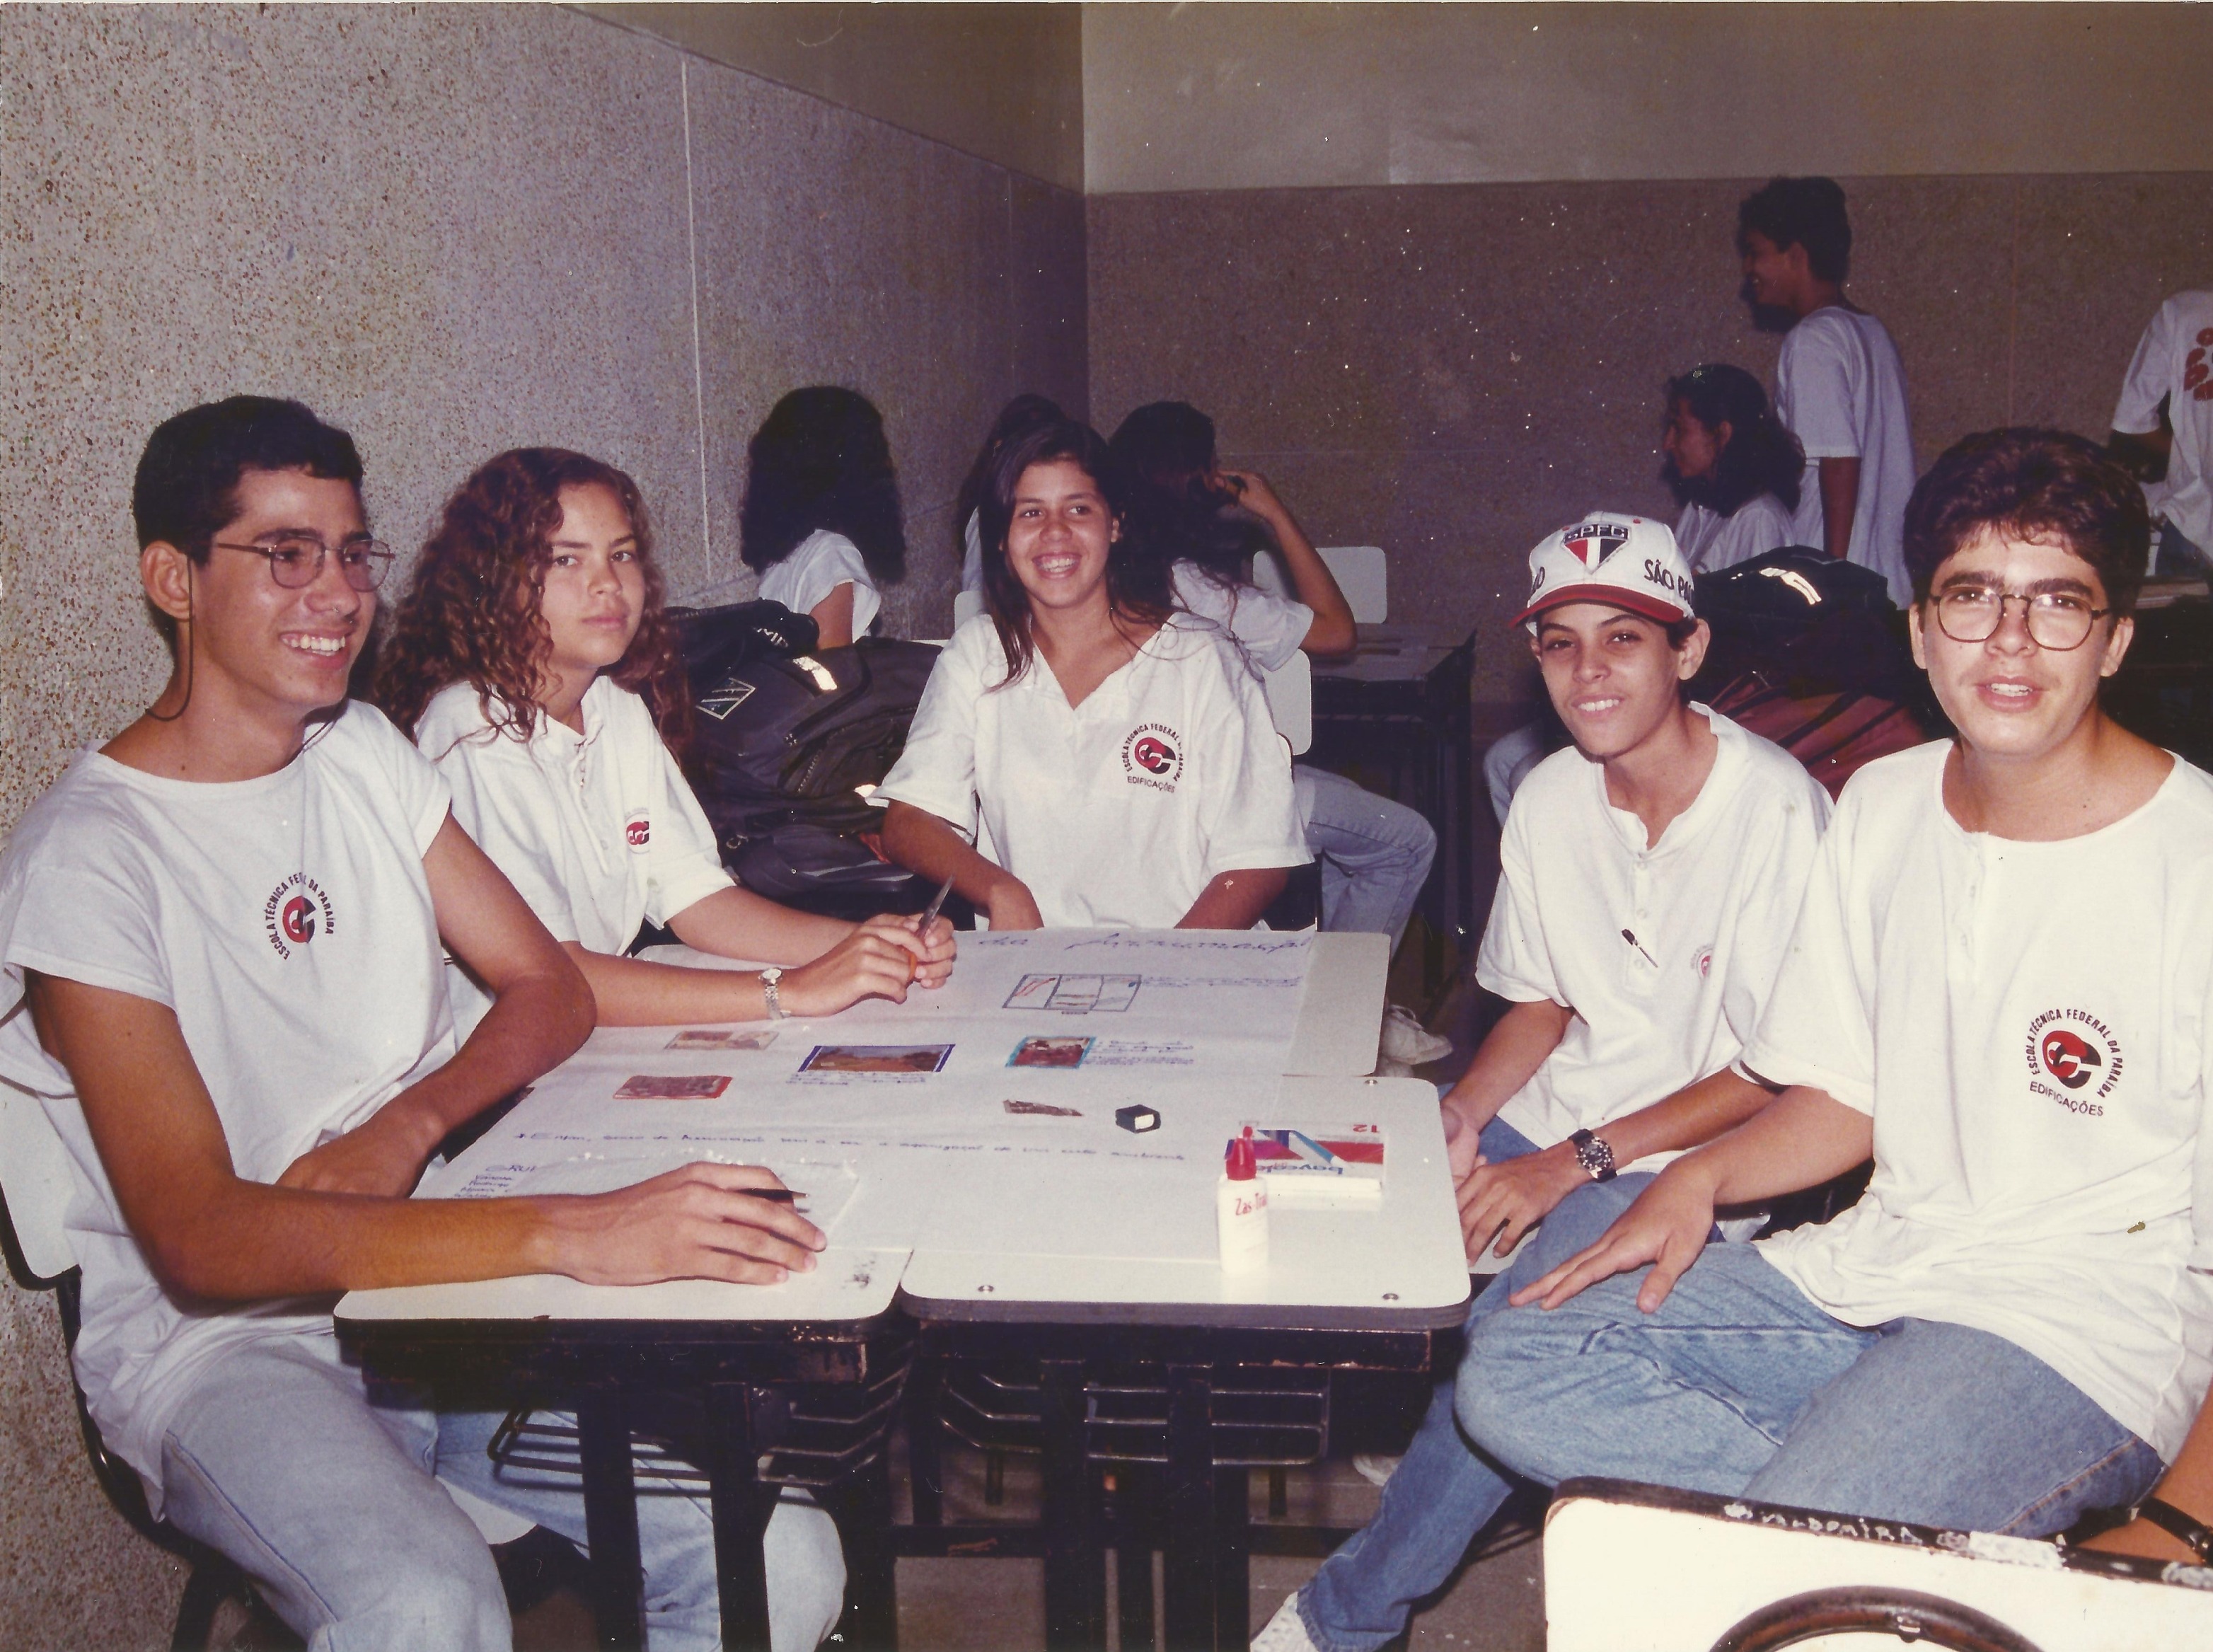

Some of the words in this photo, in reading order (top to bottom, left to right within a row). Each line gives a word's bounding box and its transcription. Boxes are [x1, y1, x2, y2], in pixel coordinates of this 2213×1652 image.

[1643, 559, 1675, 590] SÃO
[1121, 746, 1133, 772] ESCOLA
[1150, 723, 1179, 741] FEDERAL
[266, 923, 291, 960] ESCOLA
[308, 879, 319, 893] DA
[2026, 1035, 2041, 1075] ESCOLA
[2067, 1009, 2111, 1039] FEDERAL
[2107, 1040, 2121, 1053] DA
[2030, 1081, 2103, 1116] EDIFICAÇÕES
